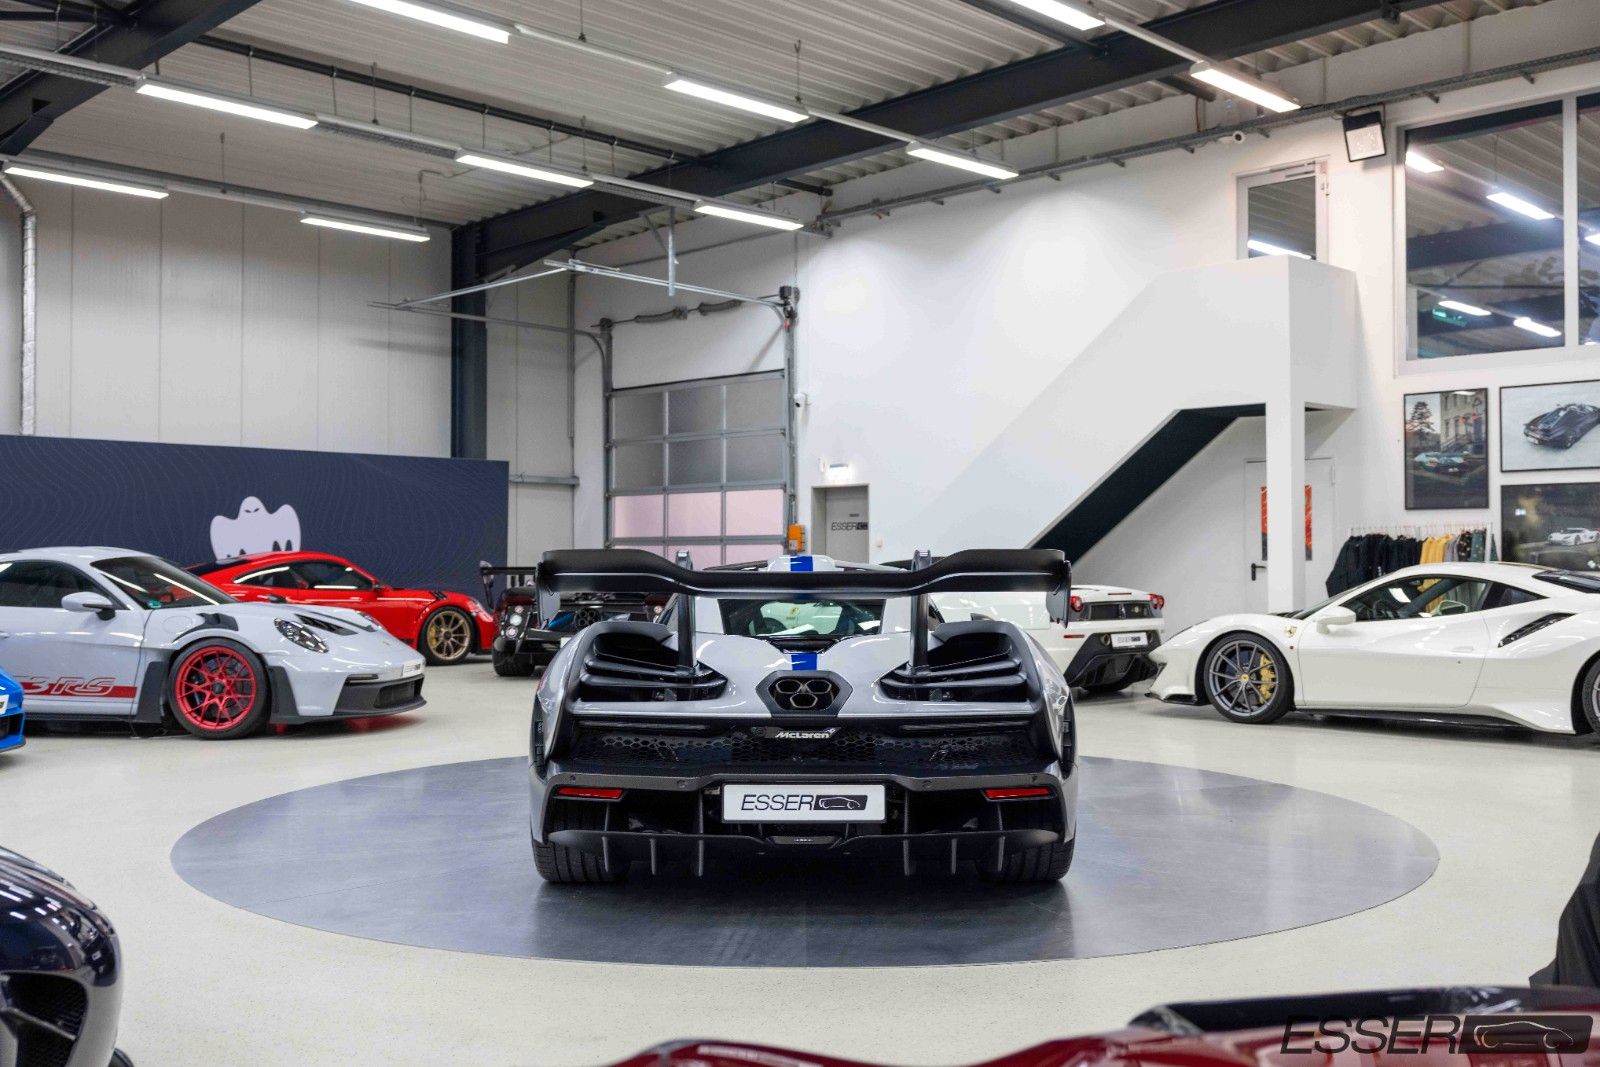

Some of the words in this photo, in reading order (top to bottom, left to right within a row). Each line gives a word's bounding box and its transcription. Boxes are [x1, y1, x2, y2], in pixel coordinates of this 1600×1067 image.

[831, 521, 858, 531] ESSER
[775, 731, 830, 739] McLaren
[741, 794, 814, 811] ESSER
